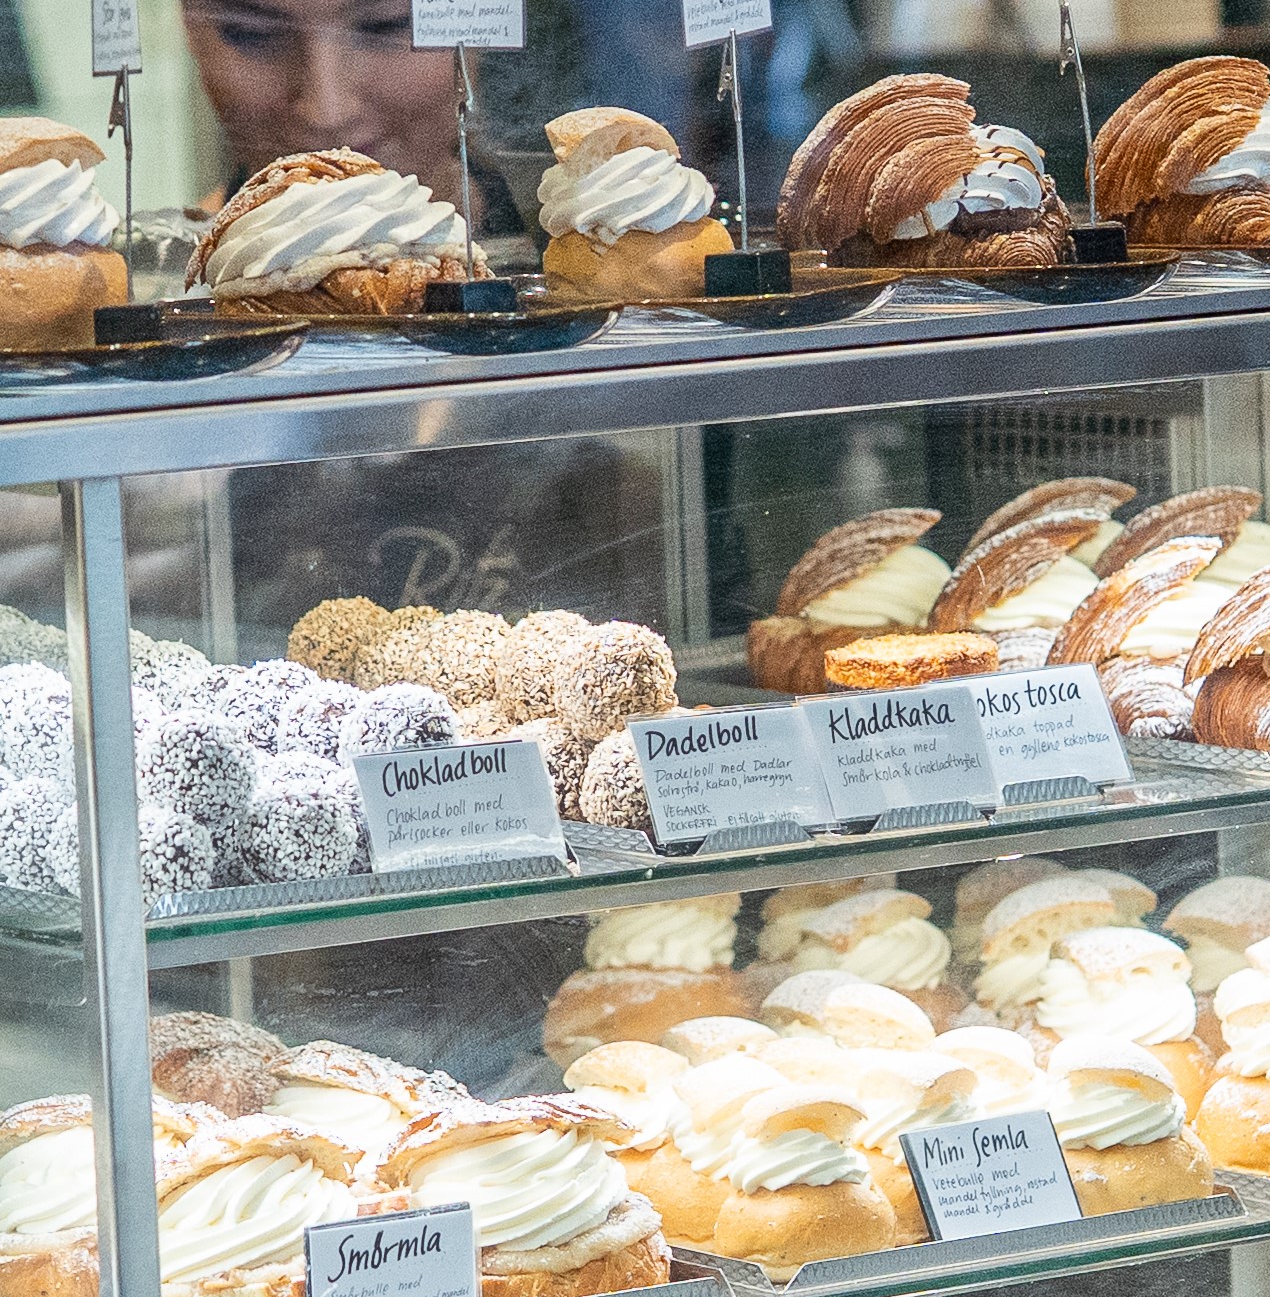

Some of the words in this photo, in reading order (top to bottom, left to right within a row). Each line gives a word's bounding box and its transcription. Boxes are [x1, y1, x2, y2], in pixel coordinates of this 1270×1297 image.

[829, 699, 955, 744] Kladdkaka
[1034, 715, 1074, 738] toppad
[645, 715, 758, 760] Dadelboll
[913, 738, 937, 753] med
[382, 747, 507, 798] Chokladboll
[655, 763, 714, 783] Dadelboll
[720, 760, 746, 773] med
[474, 794, 504, 813] med
[663, 804, 710, 818] VEGANSK
[461, 820, 487, 836] eller
[666, 820, 717, 832] SOCKERFRI
[922, 1136, 965, 1169] Mini
[972, 1125, 1028, 1168] Semla
[992, 1162, 1020, 1181] med
[327, 1225, 441, 1283] Smörmla
[398, 1275, 423, 1291] med
